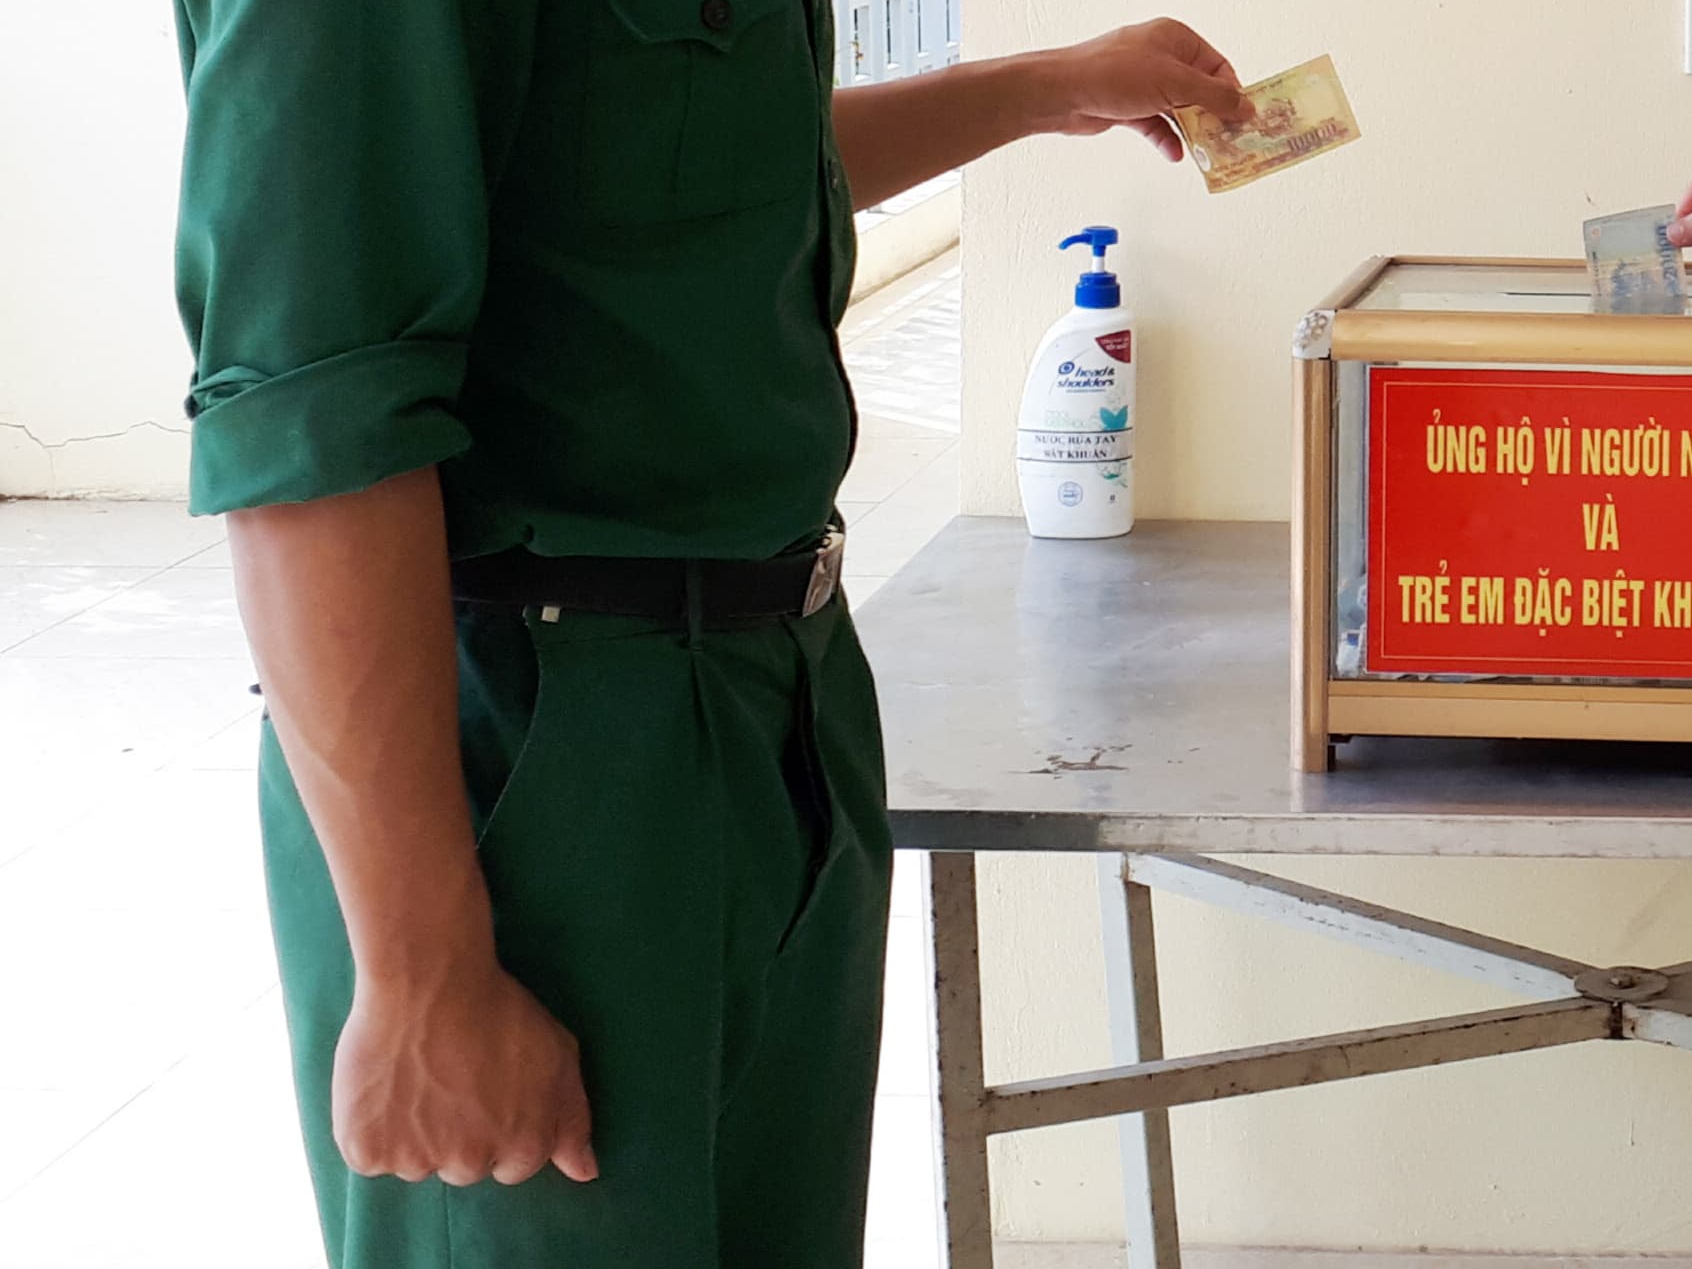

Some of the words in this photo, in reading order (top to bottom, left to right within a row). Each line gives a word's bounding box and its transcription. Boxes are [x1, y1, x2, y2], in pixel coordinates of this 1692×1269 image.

[1095, 434, 1117, 445] TAY
[1426, 408, 1487, 474] ỦNG
[1497, 416, 1535, 486] HỘ
[1544, 416, 1572, 475] VÌ
[1581, 416, 1671, 478] NGƯỜI
[1582, 493, 1620, 552] VÀ
[1398, 560, 1451, 624] TRẺ
[1461, 577, 1505, 625] EM
[1514, 567, 1572, 637] ĐẶC
[1582, 569, 1646, 638] BIỆT
